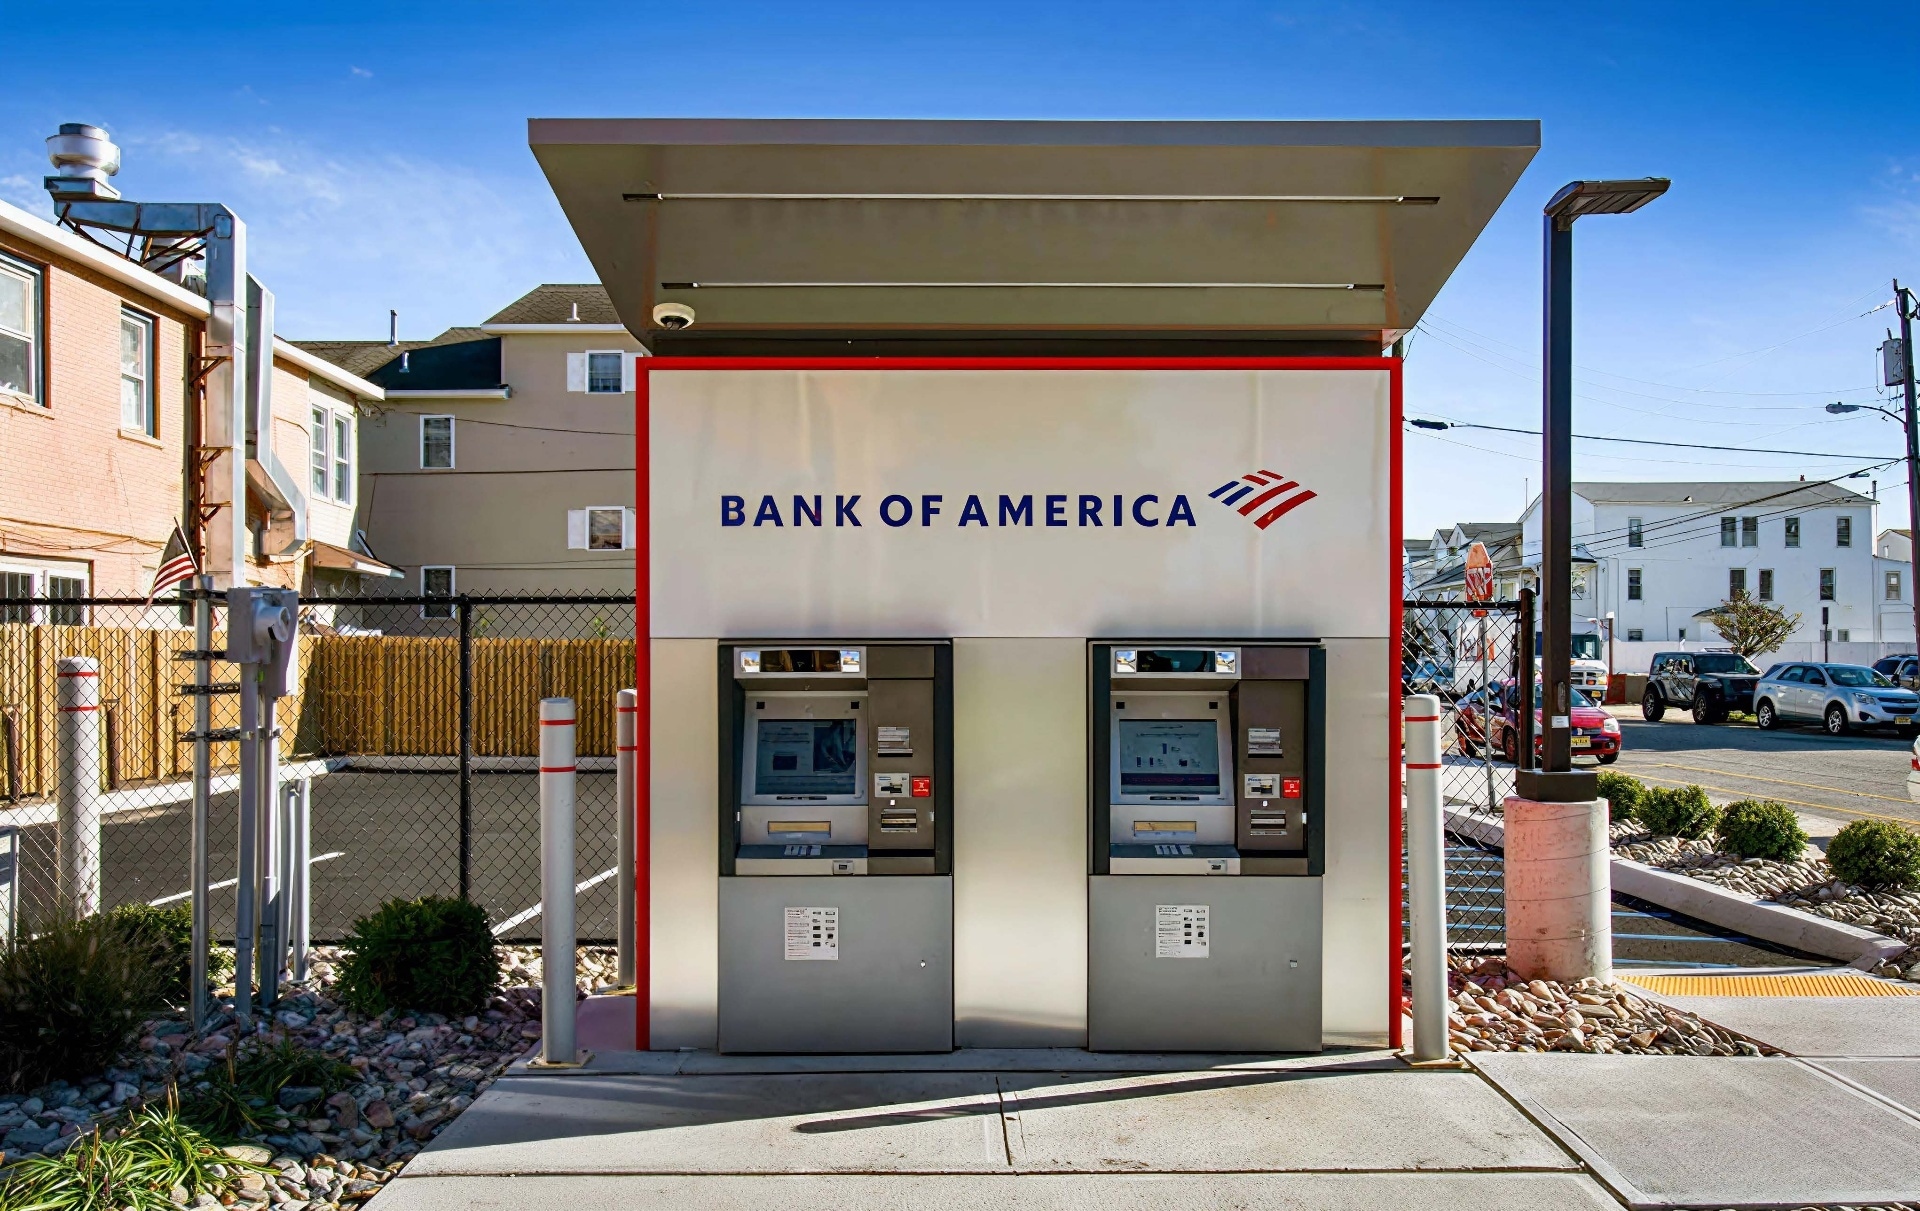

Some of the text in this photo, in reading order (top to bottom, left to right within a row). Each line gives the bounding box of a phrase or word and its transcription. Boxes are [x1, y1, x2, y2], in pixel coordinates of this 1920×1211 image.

[721, 495, 1196, 527] BANK OF AMERICA
